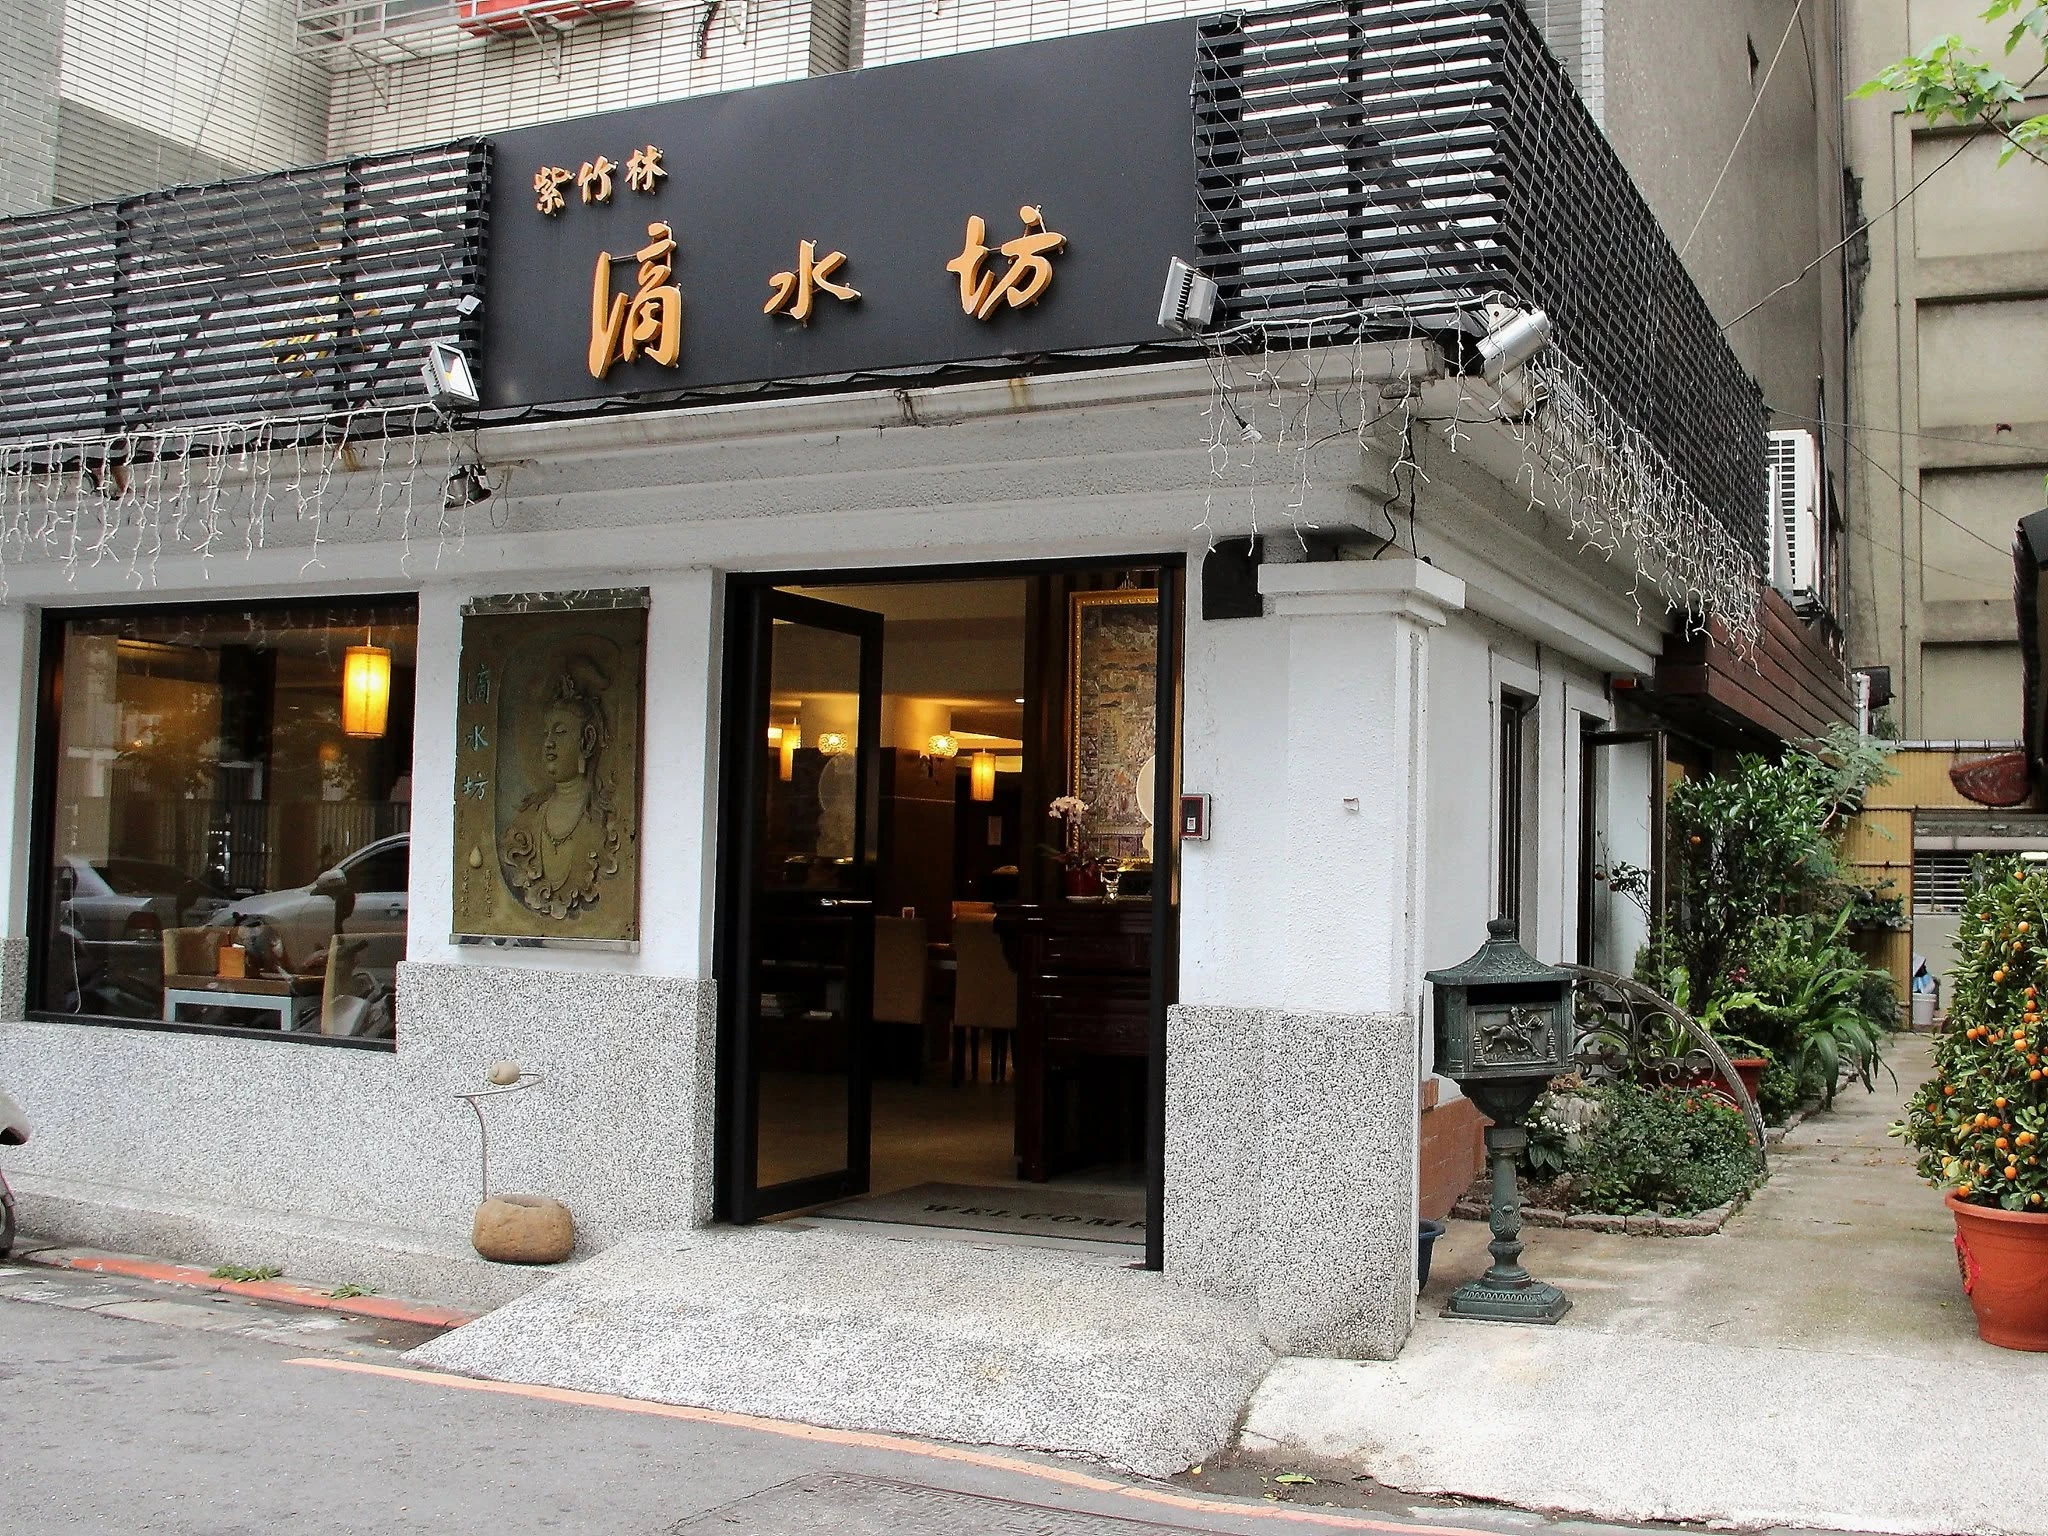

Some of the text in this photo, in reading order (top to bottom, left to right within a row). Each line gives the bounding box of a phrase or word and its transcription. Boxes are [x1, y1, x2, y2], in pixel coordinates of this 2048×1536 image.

[533, 145, 668, 215] 紫竹林
[588, 205, 1067, 379] 滴水坊
[463, 663, 491, 801] 滴水坊
